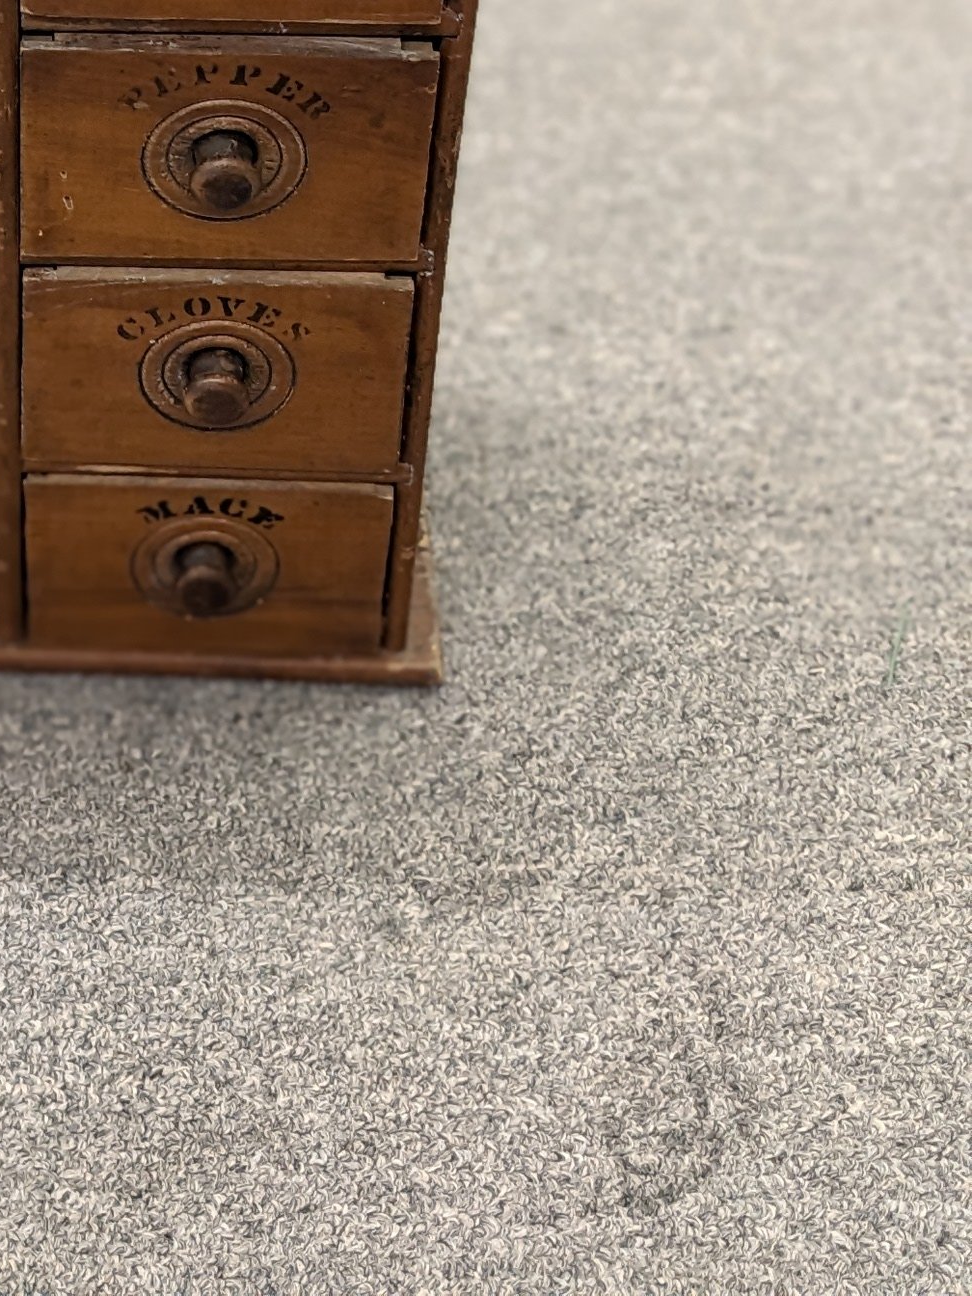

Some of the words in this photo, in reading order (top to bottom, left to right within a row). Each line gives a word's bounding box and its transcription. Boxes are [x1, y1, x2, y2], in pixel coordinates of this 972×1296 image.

[116, 64, 331, 120] PEPPER
[116, 296, 312, 341] CLOVES
[136, 496, 285, 530] MACE
